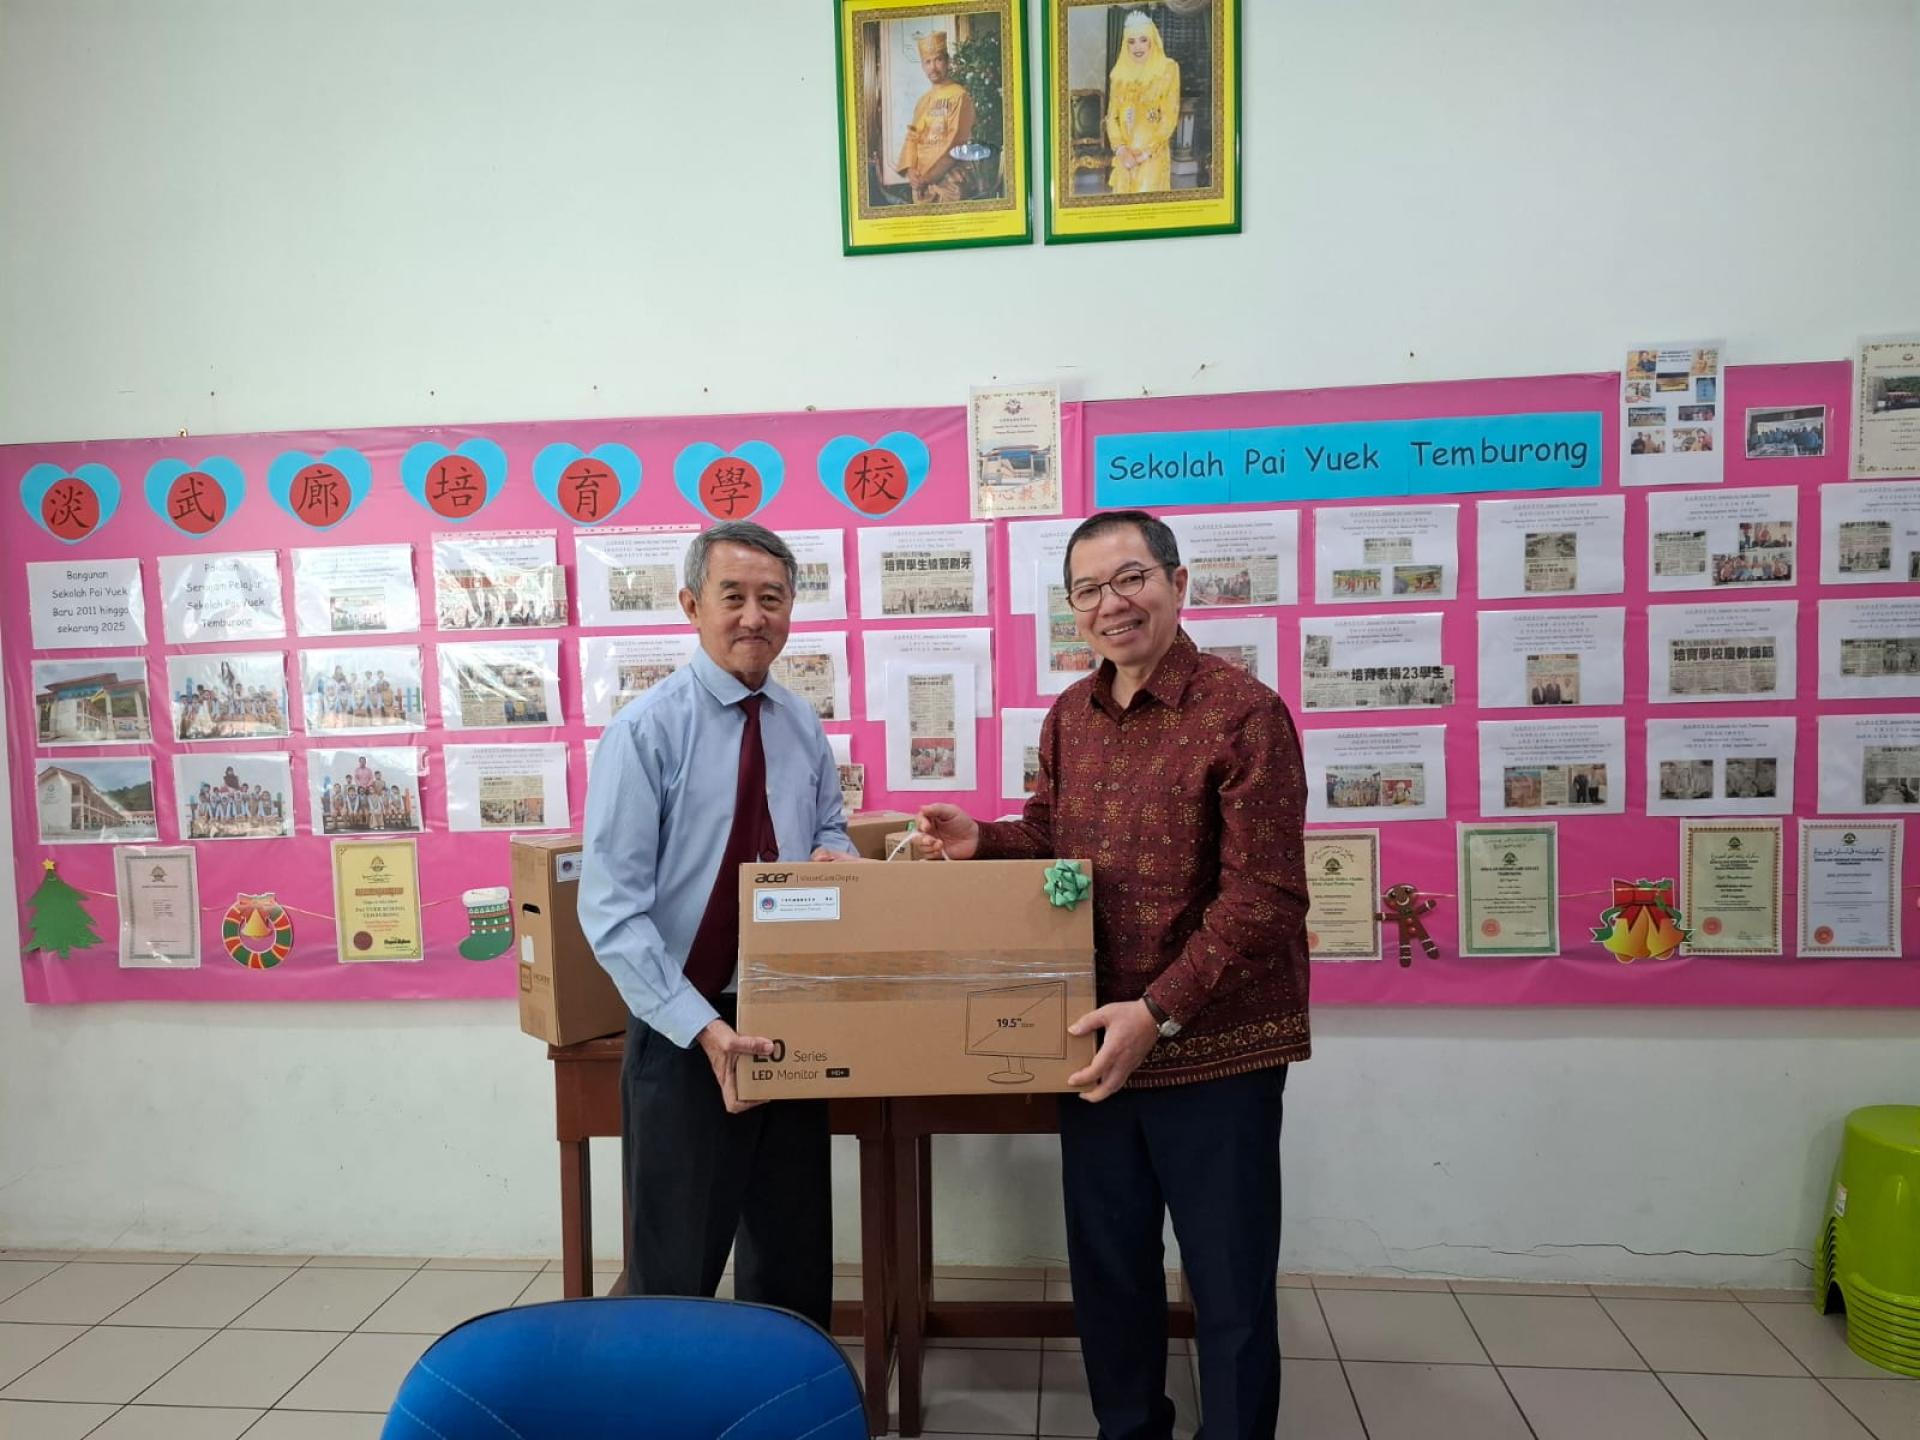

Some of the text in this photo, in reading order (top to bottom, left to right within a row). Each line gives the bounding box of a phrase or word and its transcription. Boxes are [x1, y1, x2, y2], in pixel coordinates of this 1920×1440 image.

[1109, 437, 1588, 481] Sekolah Pai Yuek Temburong
[66, 570, 109, 581] Bangunan
[52, 587, 128, 599] Sekolah Pai Yuek
[52, 605, 129, 617] Baru 2011 hingga
[57, 621, 126, 635] sekarang 2025
[754, 872, 794, 884] acer
[792, 1049, 828, 1062] Series
[751, 1069, 774, 1081] LED
[777, 1069, 819, 1080] Monitor
